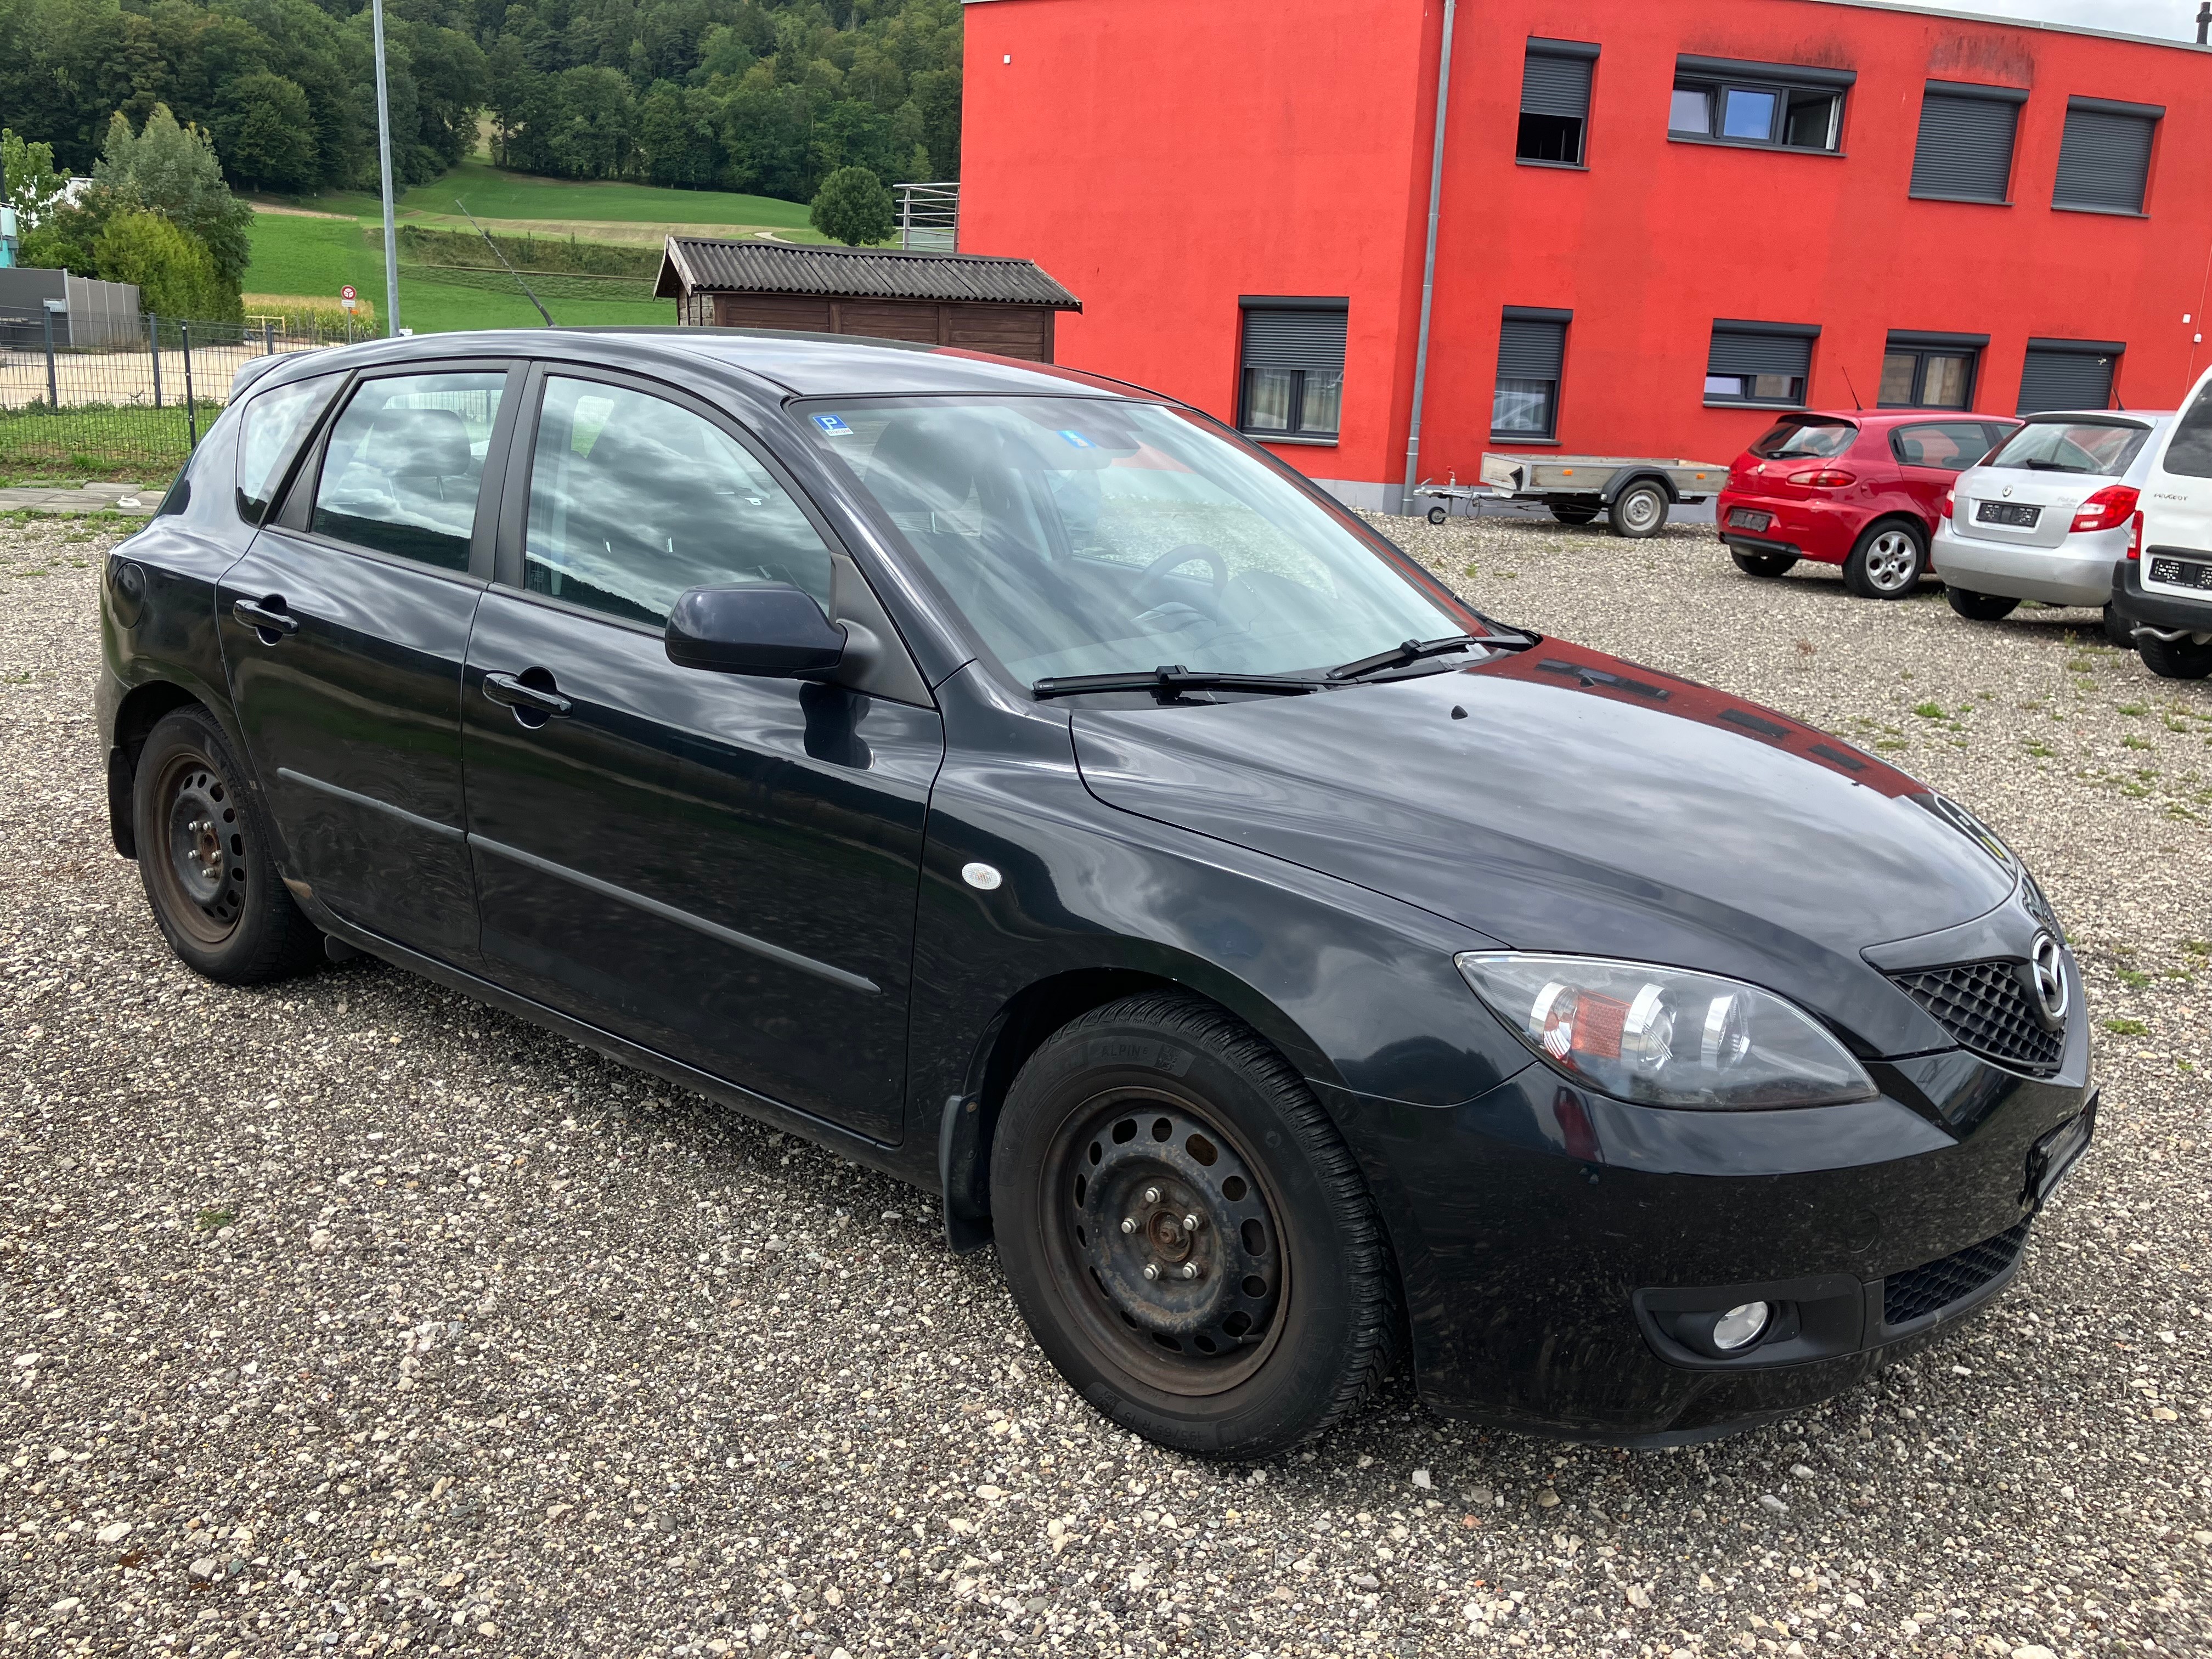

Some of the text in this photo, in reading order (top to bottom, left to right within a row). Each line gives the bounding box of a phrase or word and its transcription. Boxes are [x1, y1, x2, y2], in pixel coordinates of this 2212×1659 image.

[820, 417, 838, 430] P
[1122, 1412, 1137, 1425] 15
[1142, 1419, 1151, 1431] R
[1155, 1425, 1203, 1443] 195/65
